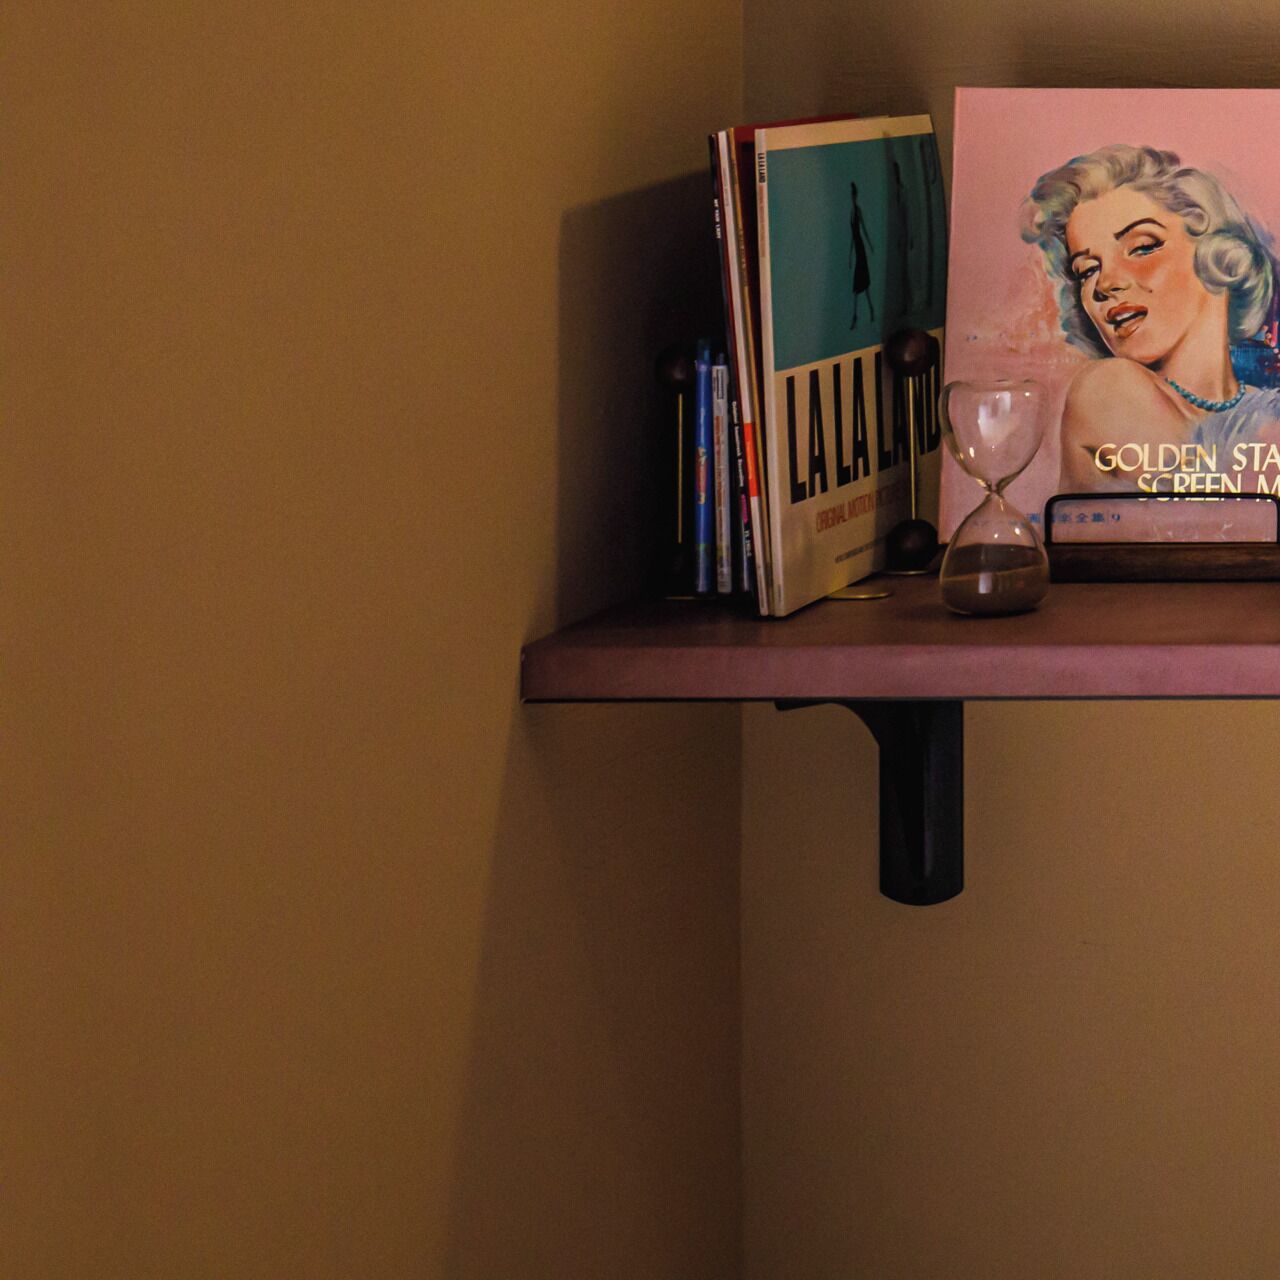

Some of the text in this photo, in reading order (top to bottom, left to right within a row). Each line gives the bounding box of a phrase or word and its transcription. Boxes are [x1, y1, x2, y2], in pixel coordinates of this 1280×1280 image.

[786, 369, 828, 504] LA
[832, 357, 870, 488] LA
[1094, 442, 1217, 473] GOLDEN
[1137, 473, 1242, 502] SCREEN
[816, 503, 848, 533] ORIGINAL
